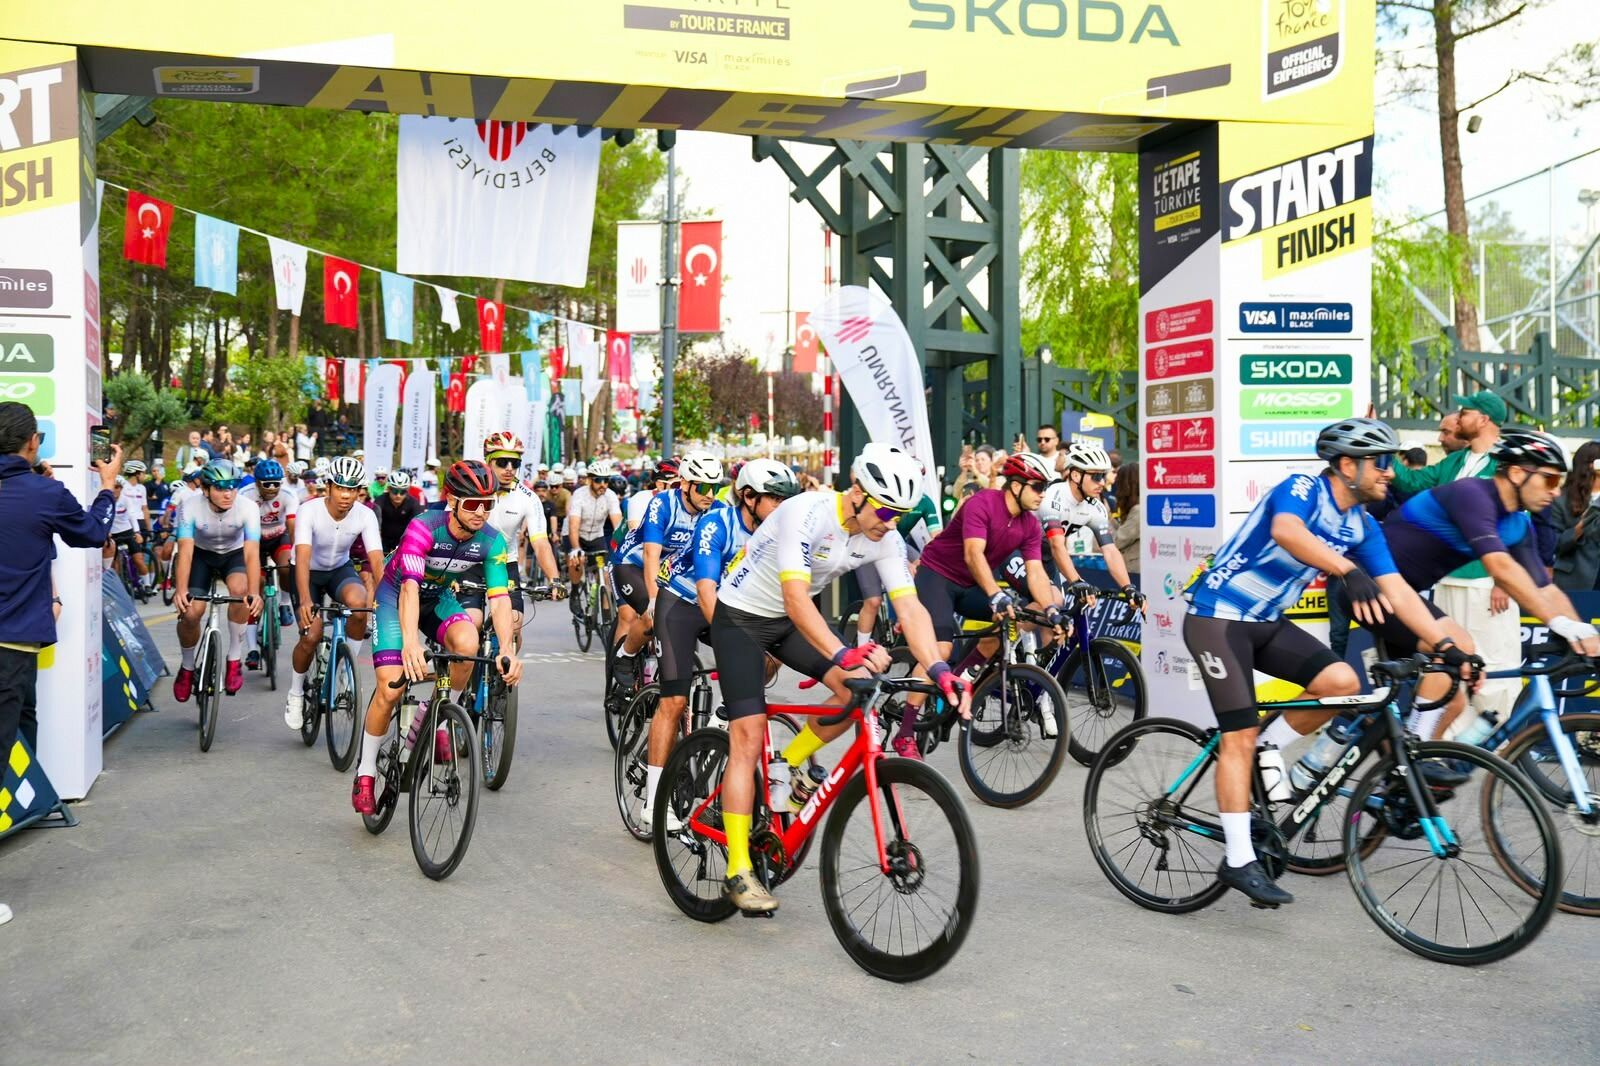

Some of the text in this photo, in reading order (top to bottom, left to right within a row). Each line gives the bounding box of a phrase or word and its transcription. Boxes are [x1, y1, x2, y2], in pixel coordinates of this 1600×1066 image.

[680, 14, 716, 32] TOUR
[717, 18, 735, 33] DE
[736, 19, 786, 37] FRANCE
[674, 50, 708, 65] VISA
[1281, 44, 1325, 70] OFFICIAL
[1273, 54, 1333, 86] EXPERIENCE
[1229, 140, 1364, 240] START
[1277, 213, 1355, 268] FINISH
[1242, 308, 1350, 325] VISA maximiles
[1252, 392, 1343, 407] MOSSO
[1250, 430, 1316, 448] SHIMA
[518, 484, 532, 498] VISA
[699, 521, 718, 556] opet
[800, 541, 811, 568] VISA
[731, 566, 750, 589] VISA
[1205, 551, 1248, 590] opet
